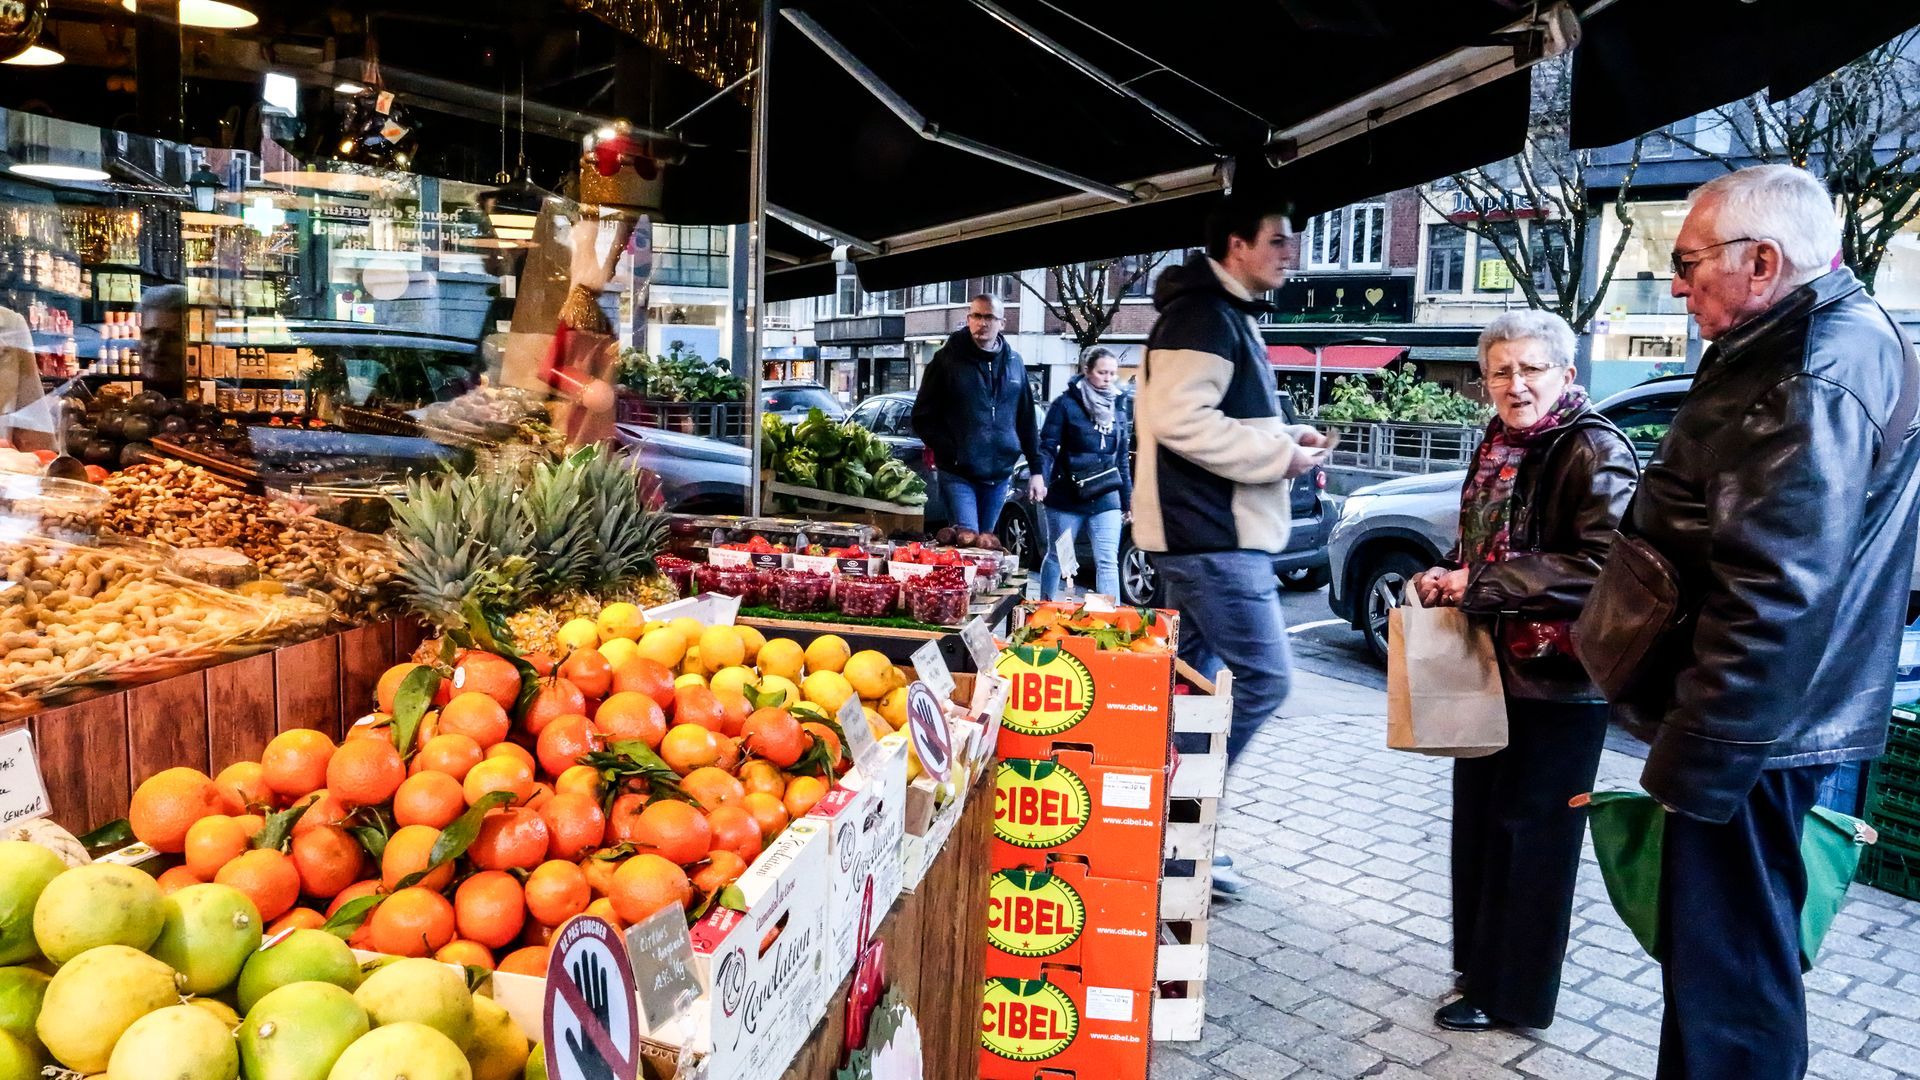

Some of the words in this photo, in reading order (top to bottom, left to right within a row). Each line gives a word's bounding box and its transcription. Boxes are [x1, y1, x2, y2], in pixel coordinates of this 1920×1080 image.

[998, 672, 1084, 713] IBEL
[1106, 702, 1158, 712] www.cibel.be
[994, 786, 1080, 827] CIBEL
[1102, 816, 1154, 827] www.cibel.be
[987, 896, 1075, 935] CIBEL
[566, 922, 580, 944] PAS
[579, 919, 608, 941] TOUCHER
[1096, 926, 1148, 937] www.cibel.be
[982, 1001, 1068, 1040] CIBEL
[1090, 1032, 1140, 1043] www.cibel.be
